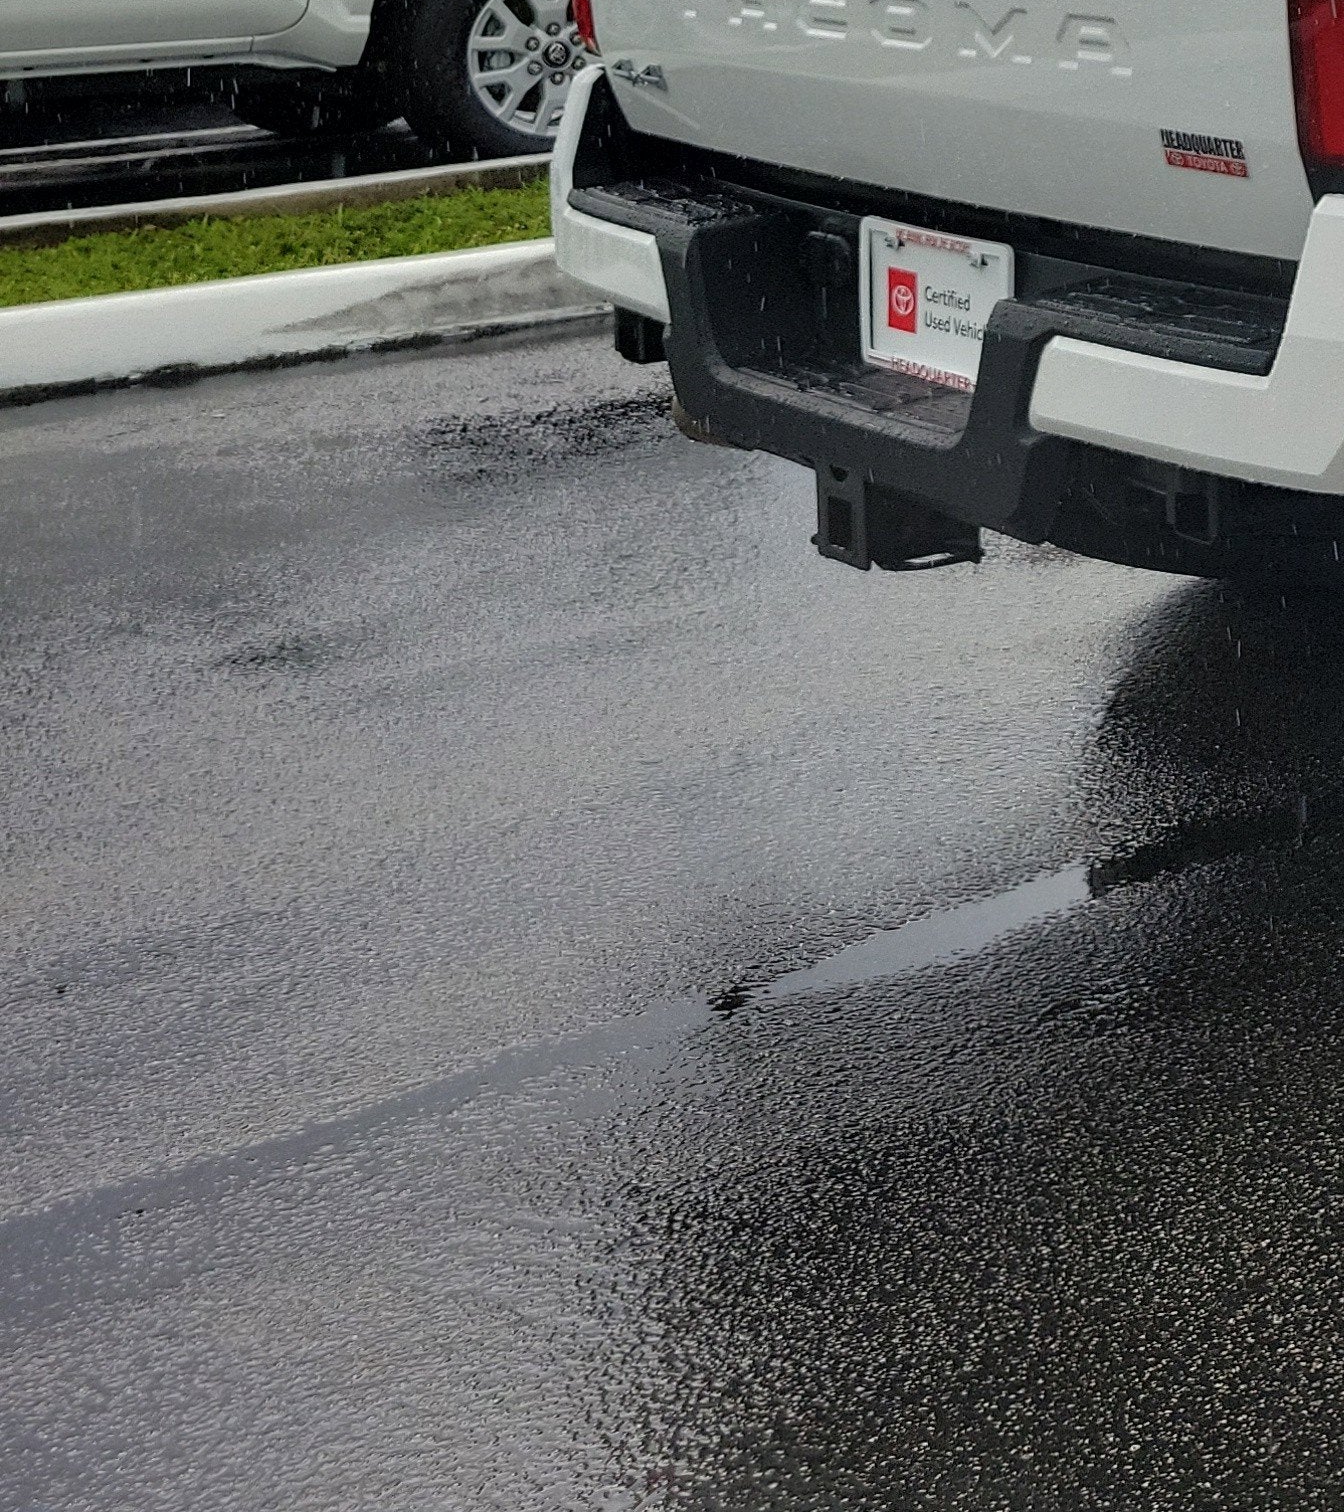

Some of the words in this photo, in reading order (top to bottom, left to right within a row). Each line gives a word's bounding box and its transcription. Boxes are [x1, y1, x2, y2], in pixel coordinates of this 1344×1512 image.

[1160, 128, 1245, 160] HEADQUARTER
[1188, 154, 1228, 173] TOYOTA
[925, 285, 970, 312] Certified
[925, 311, 951, 333] Used
[891, 355, 971, 391] HEADQUARTER
